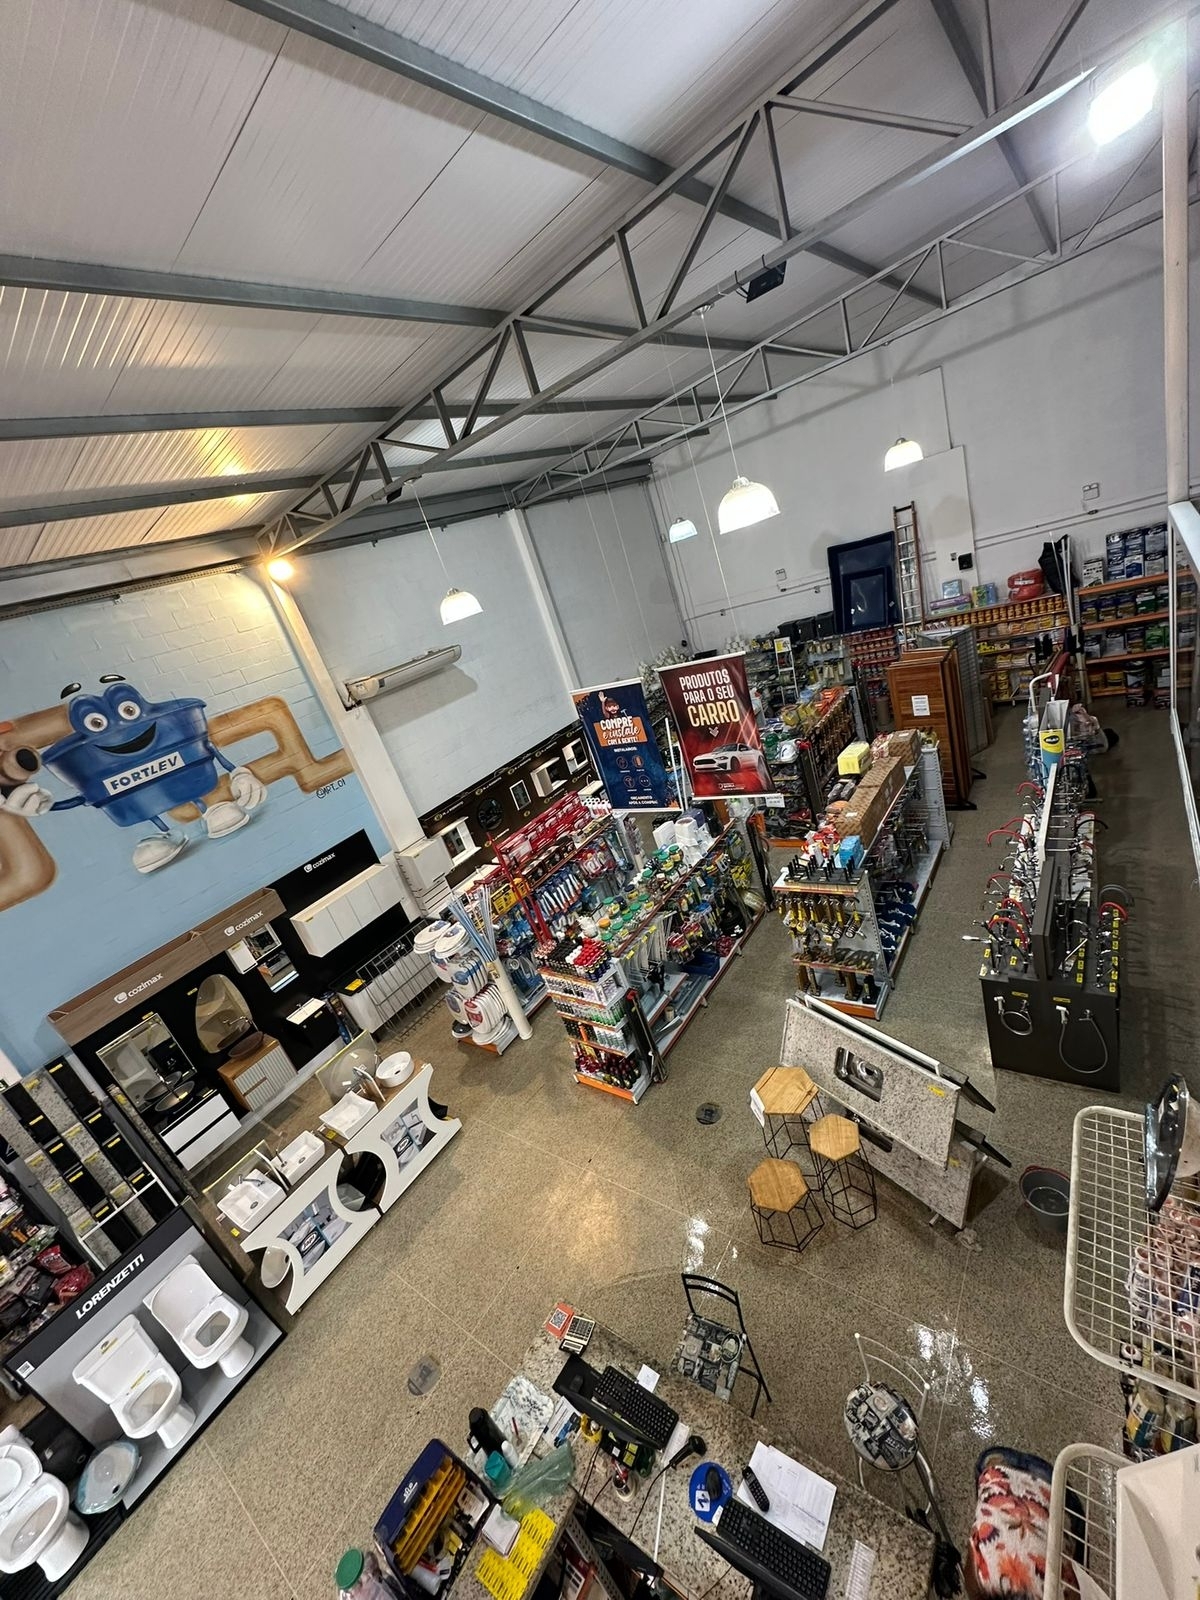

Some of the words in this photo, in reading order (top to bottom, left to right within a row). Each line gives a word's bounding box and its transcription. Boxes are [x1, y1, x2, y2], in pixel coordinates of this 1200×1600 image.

[678, 668, 730, 690] PRODUTOS
[683, 690, 707, 705] PARA
[707, 688, 715, 701] O
[716, 684, 735, 699] SEU
[600, 716, 634, 730] COMPRE
[687, 700, 741, 728] CARRO
[109, 755, 180, 792] FORTLEV
[312, 852, 336, 870] cozimax
[235, 910, 264, 932] cozimax
[127, 973, 164, 998] cozimax
[75, 1253, 145, 1320] LORENZETTI
